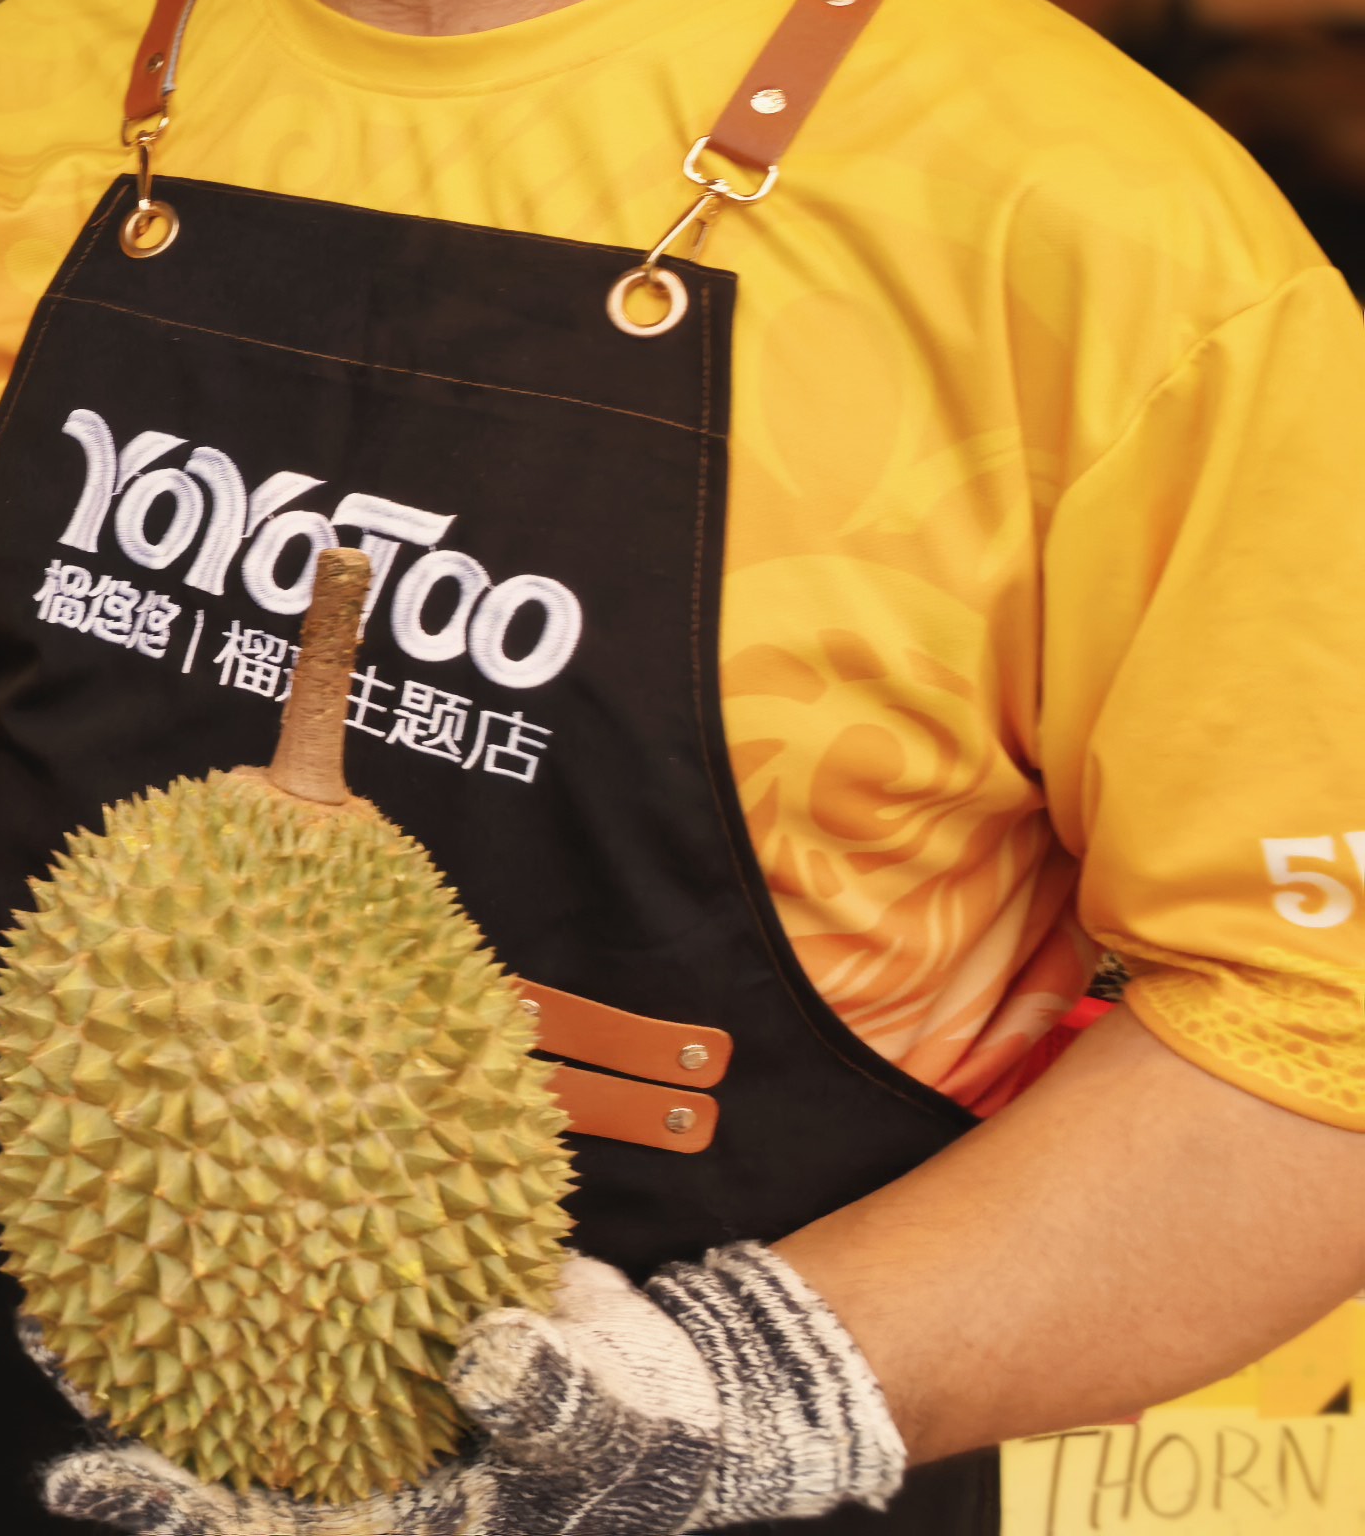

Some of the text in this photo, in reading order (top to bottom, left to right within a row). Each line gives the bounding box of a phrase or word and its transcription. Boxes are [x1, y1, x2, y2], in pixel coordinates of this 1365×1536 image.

[33, 559, 553, 784] 榴悠悠 榴主题店
[1021, 1420, 1336, 1536] THORN
